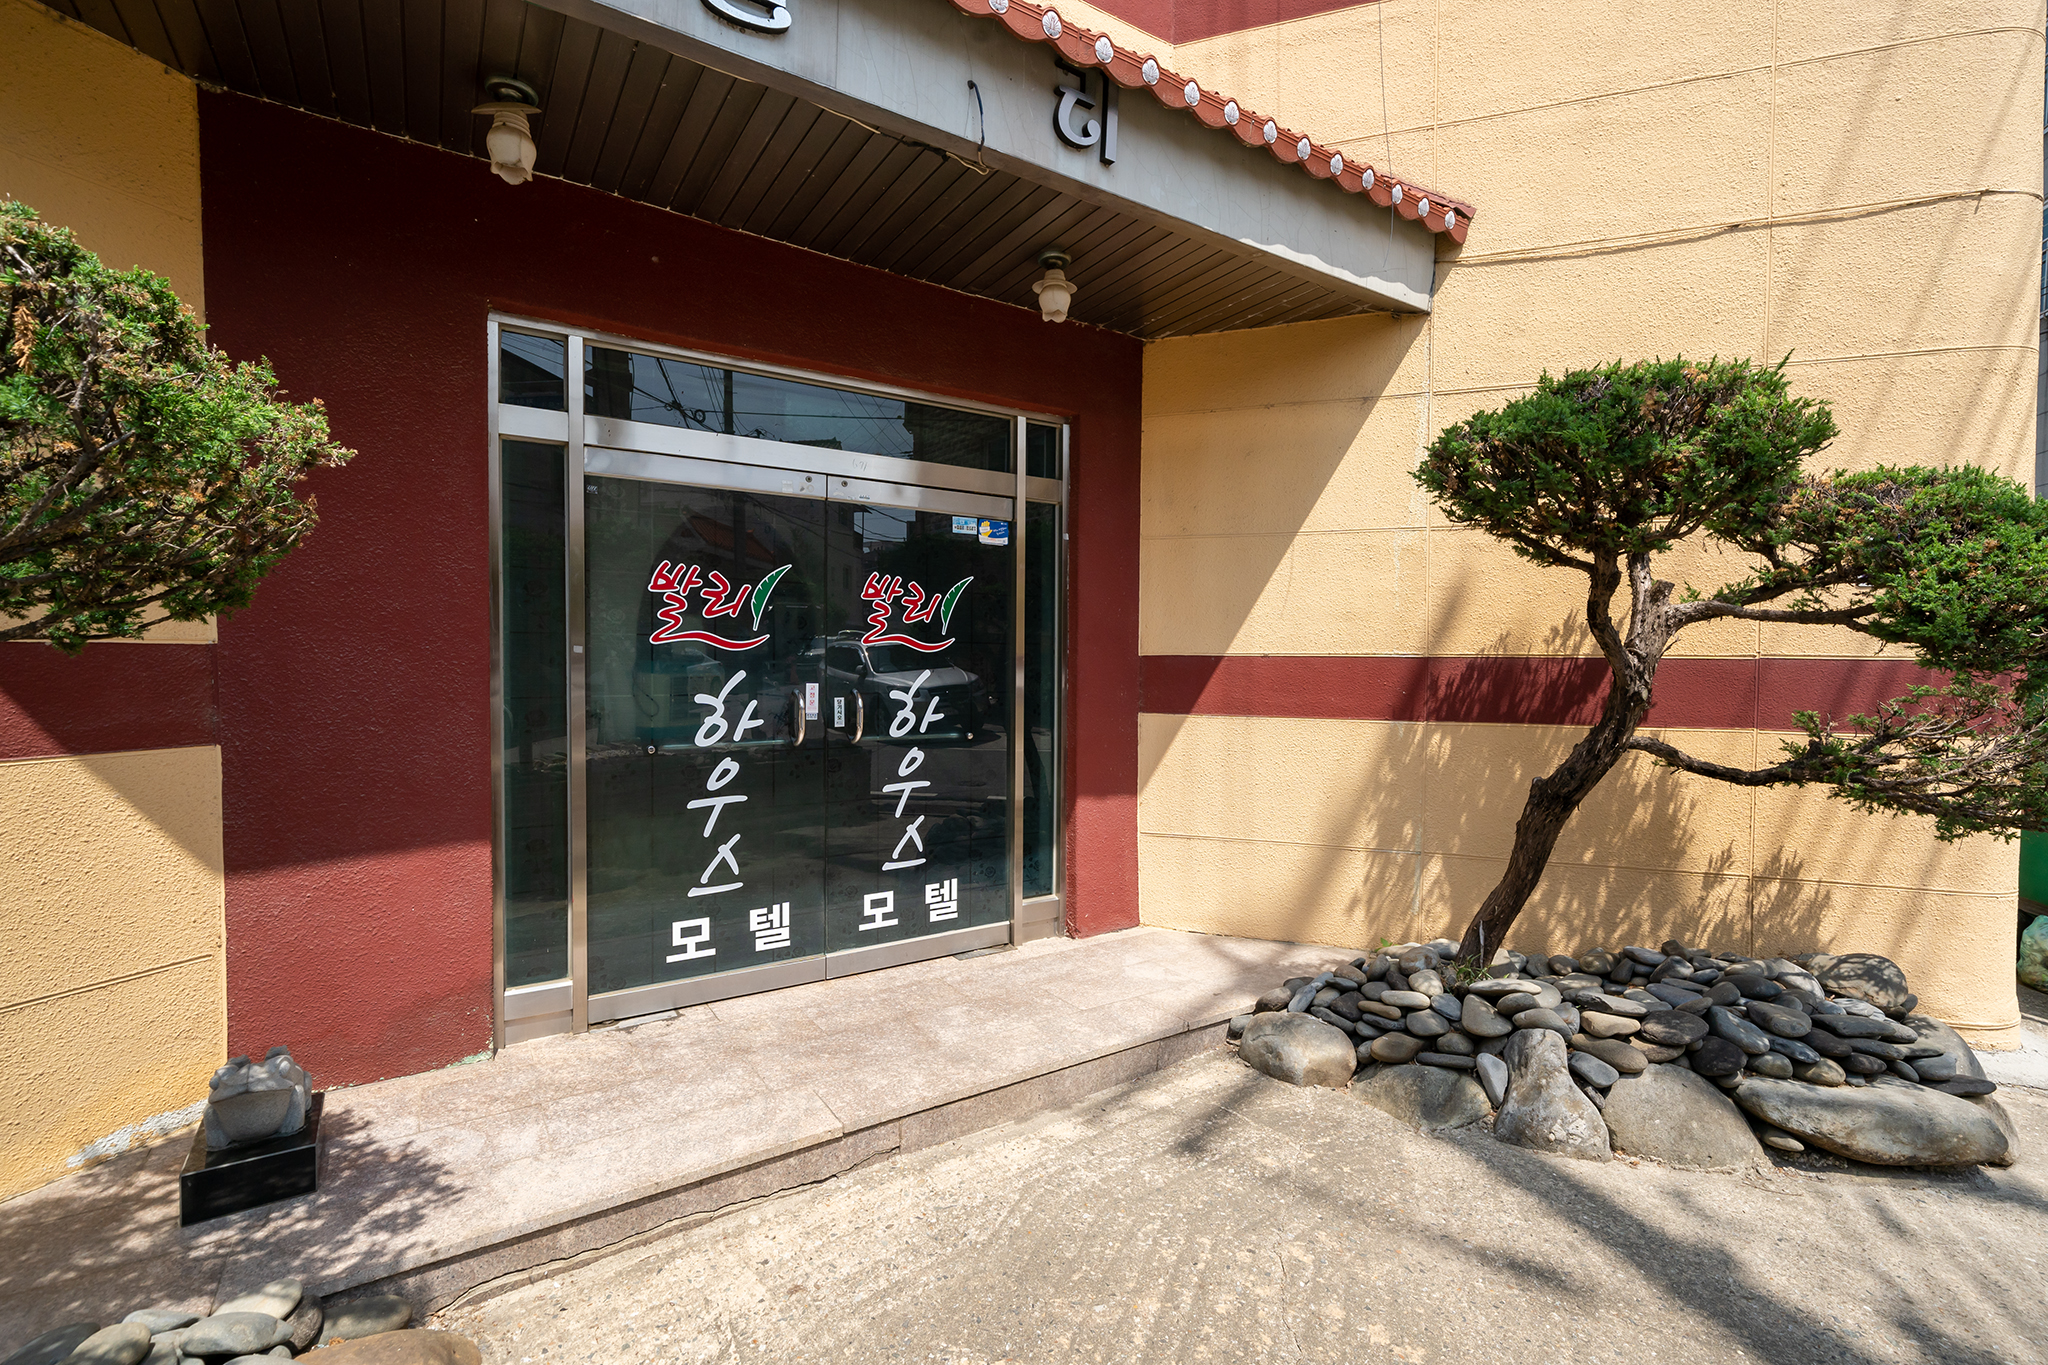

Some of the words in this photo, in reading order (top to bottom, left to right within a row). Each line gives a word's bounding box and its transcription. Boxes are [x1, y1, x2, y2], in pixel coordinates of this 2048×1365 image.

[648, 559, 770, 651] 발리
[860, 571, 955, 653] 발리
[686, 669, 765, 898] 하우스
[881, 669, 945, 871] 하우스
[666, 901, 791, 964] 모텔
[859, 877, 959, 932] 모텔
